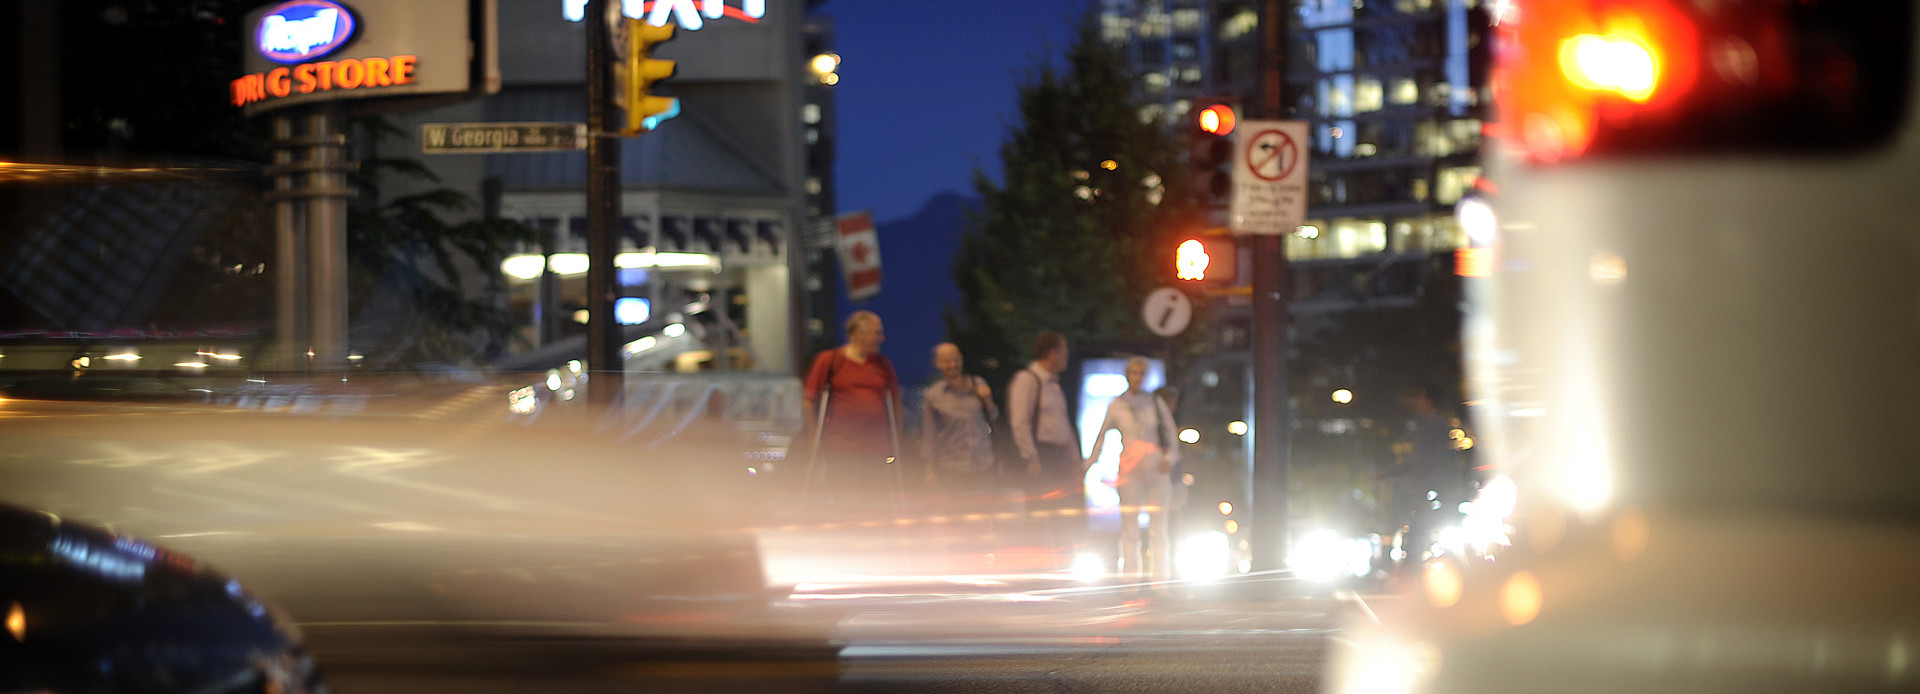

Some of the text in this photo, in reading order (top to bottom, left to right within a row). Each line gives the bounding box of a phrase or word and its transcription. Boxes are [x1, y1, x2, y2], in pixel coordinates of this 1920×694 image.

[293, 55, 417, 94] STORE
[430, 127, 447, 147] W
[452, 128, 519, 150] Georgia
